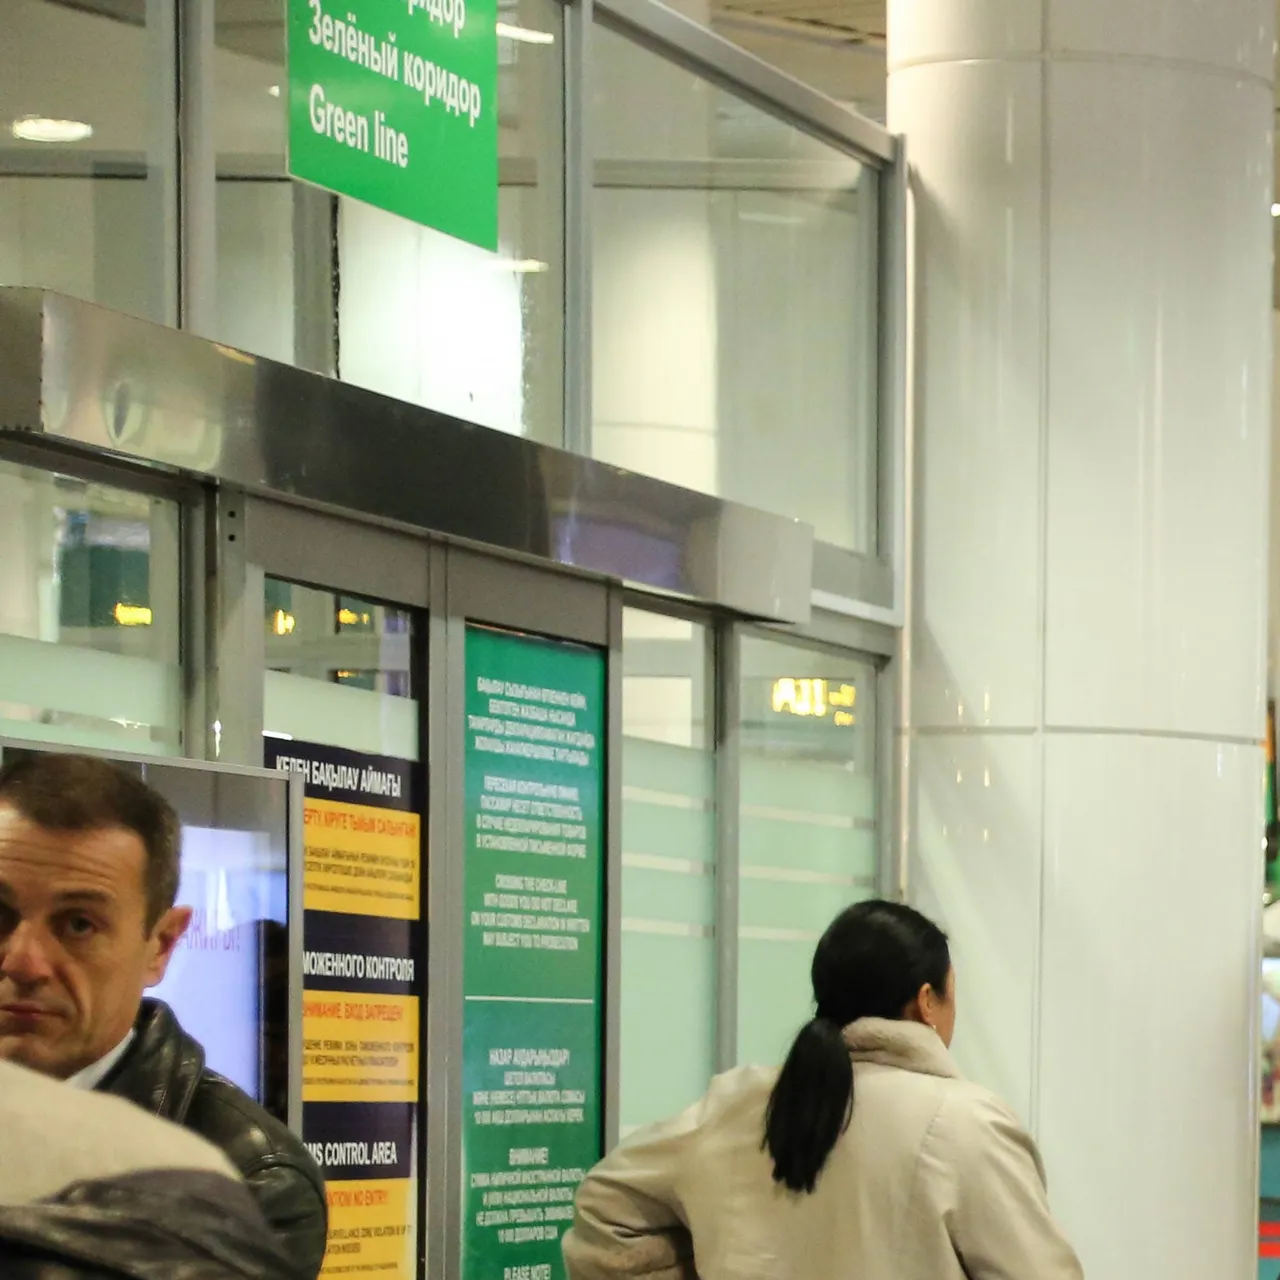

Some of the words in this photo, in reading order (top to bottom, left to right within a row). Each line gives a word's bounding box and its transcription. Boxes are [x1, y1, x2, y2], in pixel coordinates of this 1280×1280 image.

[308, 0, 399, 81] Зелёный
[403, 51, 481, 128] коридор
[308, 83, 369, 153] Green
[374, 110, 409, 168] line
[366, 955, 414, 982] КОНТРОЛЯ
[325, 1142, 370, 1167] CONTROL
[371, 1141, 398, 1165] AREA
